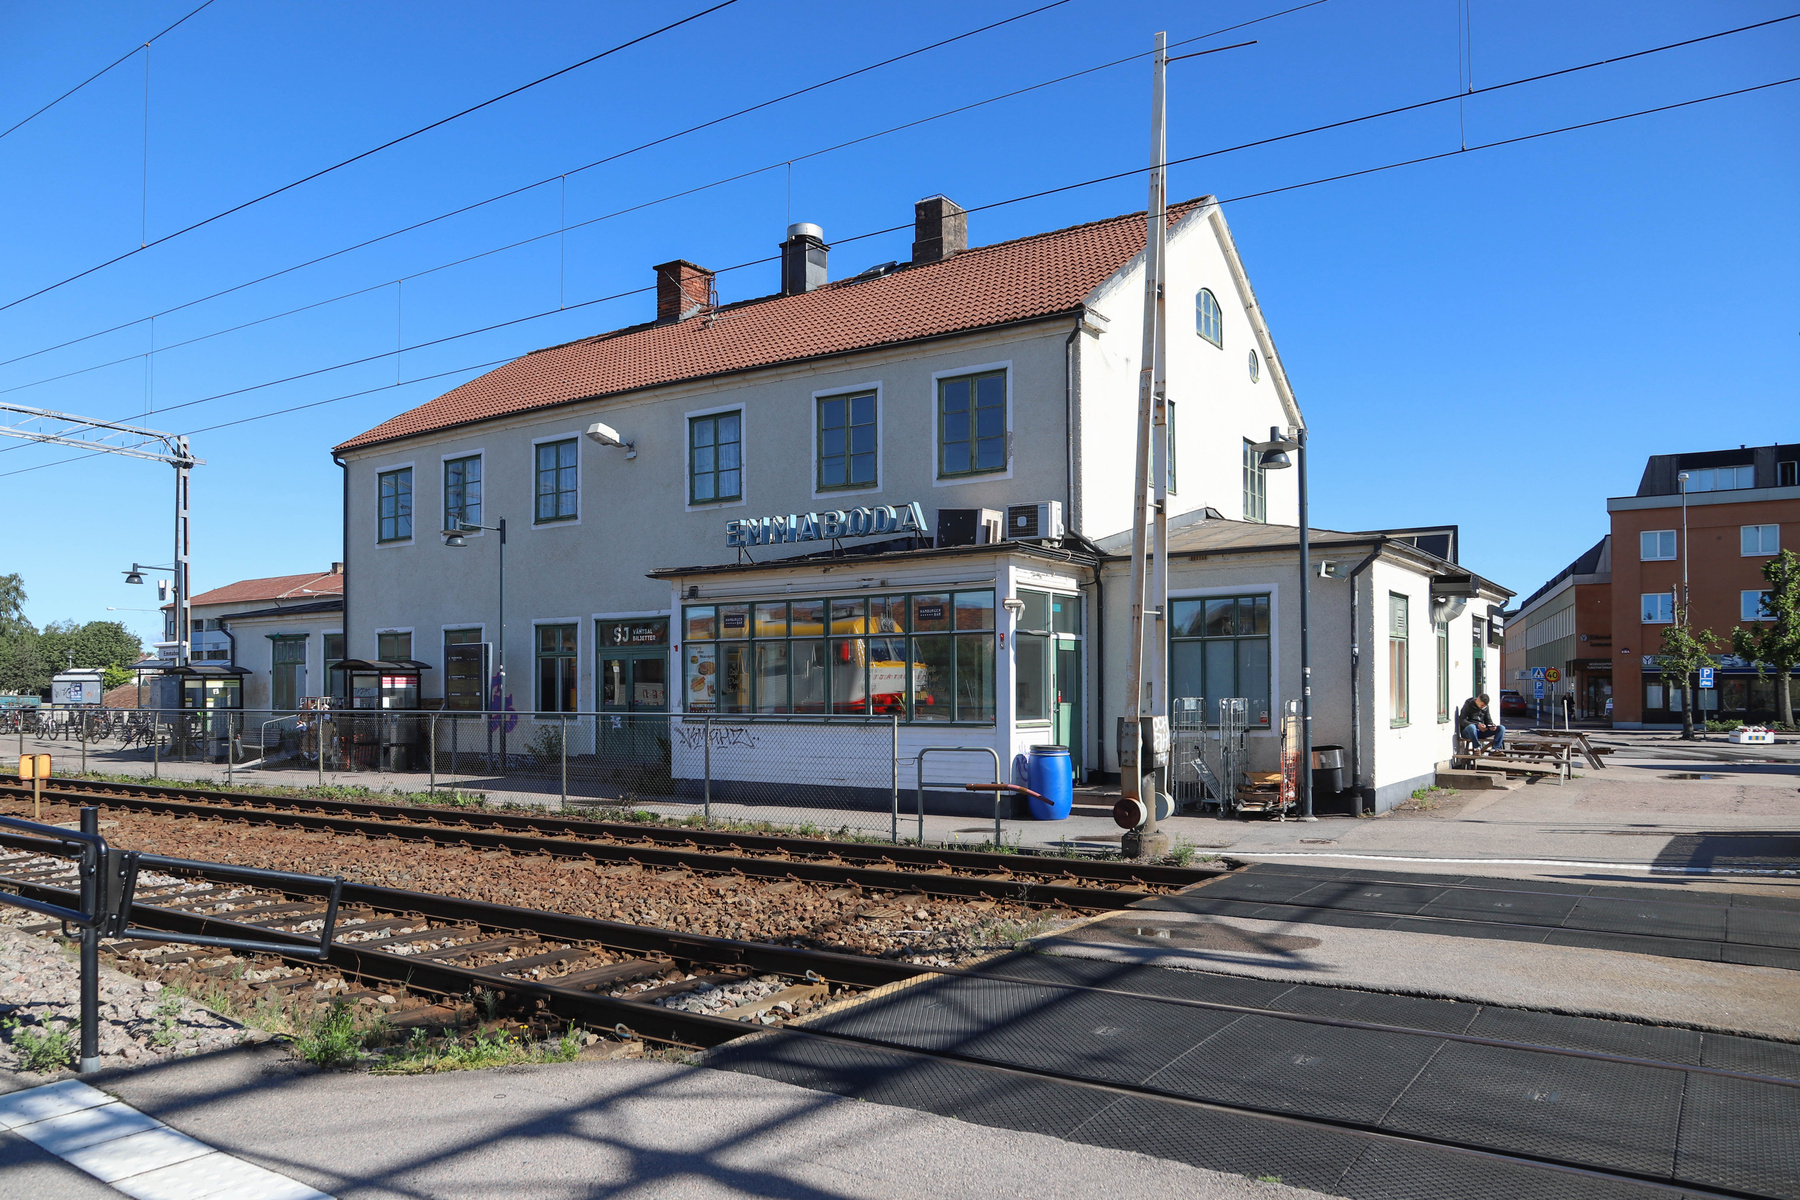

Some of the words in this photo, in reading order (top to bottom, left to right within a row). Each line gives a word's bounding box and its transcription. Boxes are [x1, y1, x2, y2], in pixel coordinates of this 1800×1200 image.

[726, 501, 928, 548] EMMABODA
[613, 626, 629, 642] SJ
[1547, 671, 1558, 679] 40
[1703, 669, 1711, 678] P
[1536, 681, 1542, 689] P
